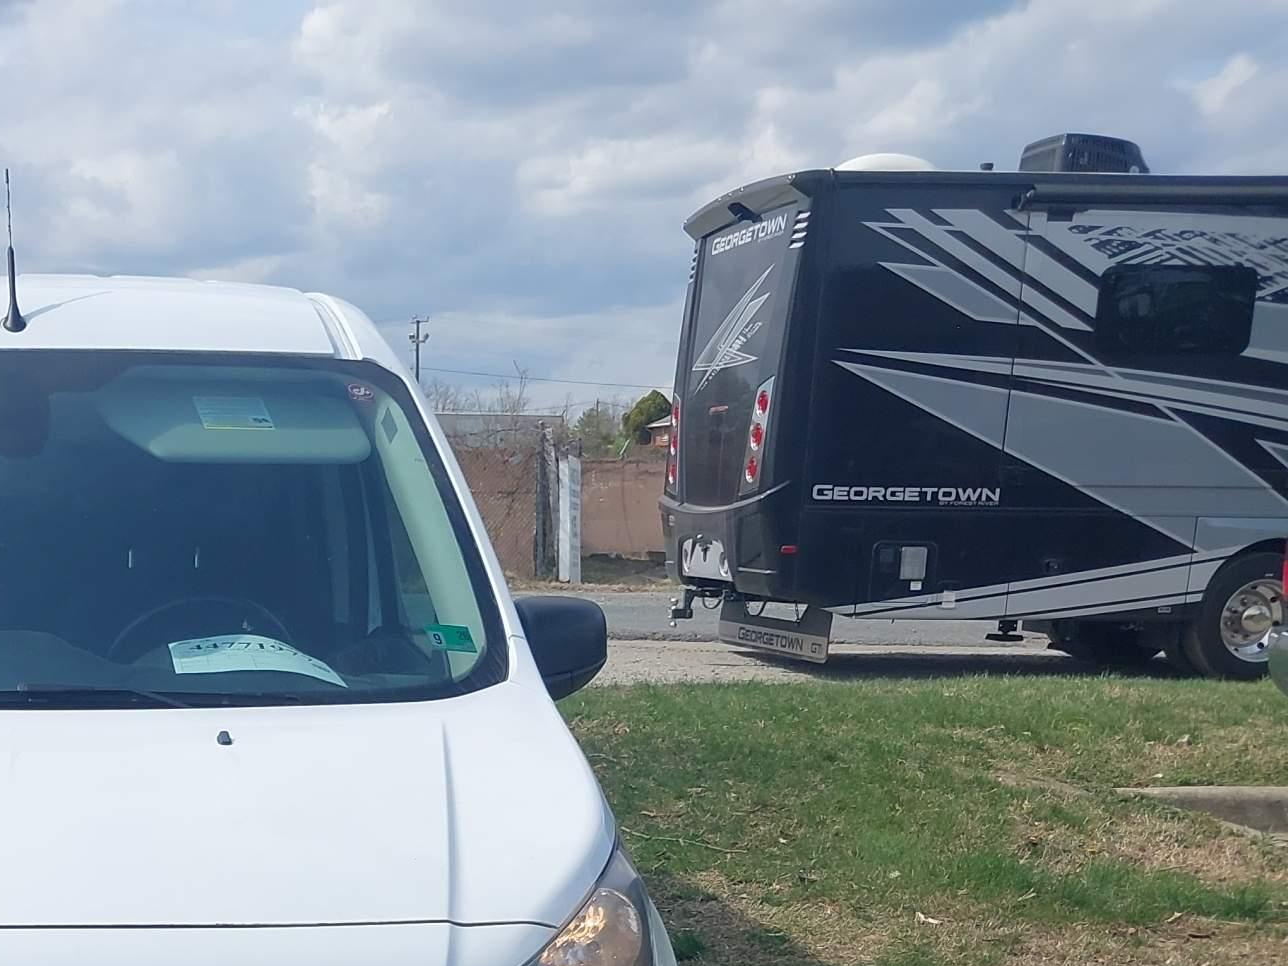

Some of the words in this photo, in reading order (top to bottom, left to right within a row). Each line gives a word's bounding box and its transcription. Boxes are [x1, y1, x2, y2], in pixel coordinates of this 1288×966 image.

[711, 213, 787, 255] GEORGETOWN
[812, 484, 1000, 502] GEORGETOWN
[738, 627, 803, 651] GEORGETOWN
